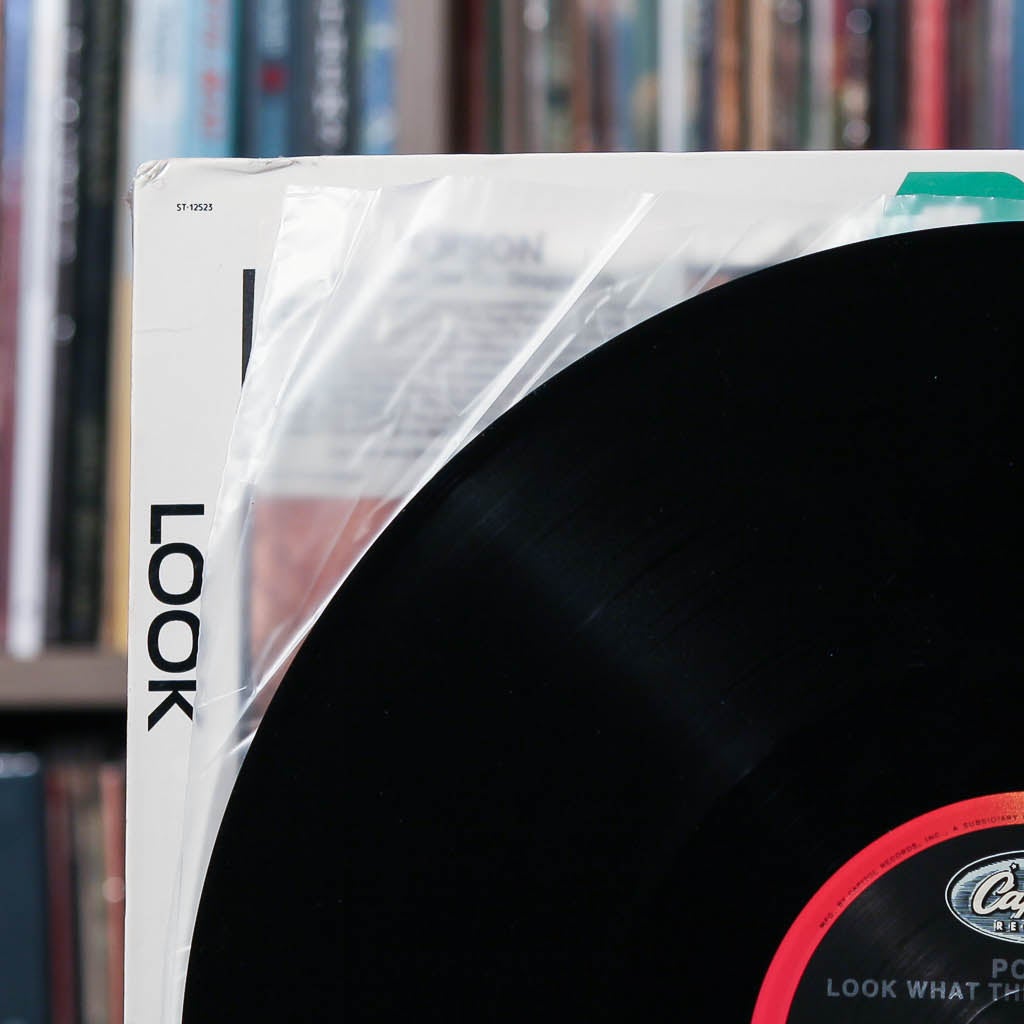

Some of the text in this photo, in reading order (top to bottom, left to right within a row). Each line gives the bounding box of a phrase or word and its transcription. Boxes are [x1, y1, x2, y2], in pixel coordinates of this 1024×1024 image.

[147, 503, 205, 732] LOOK
[826, 978, 897, 998] LOOK
[906, 980, 980, 1000] WHAT
